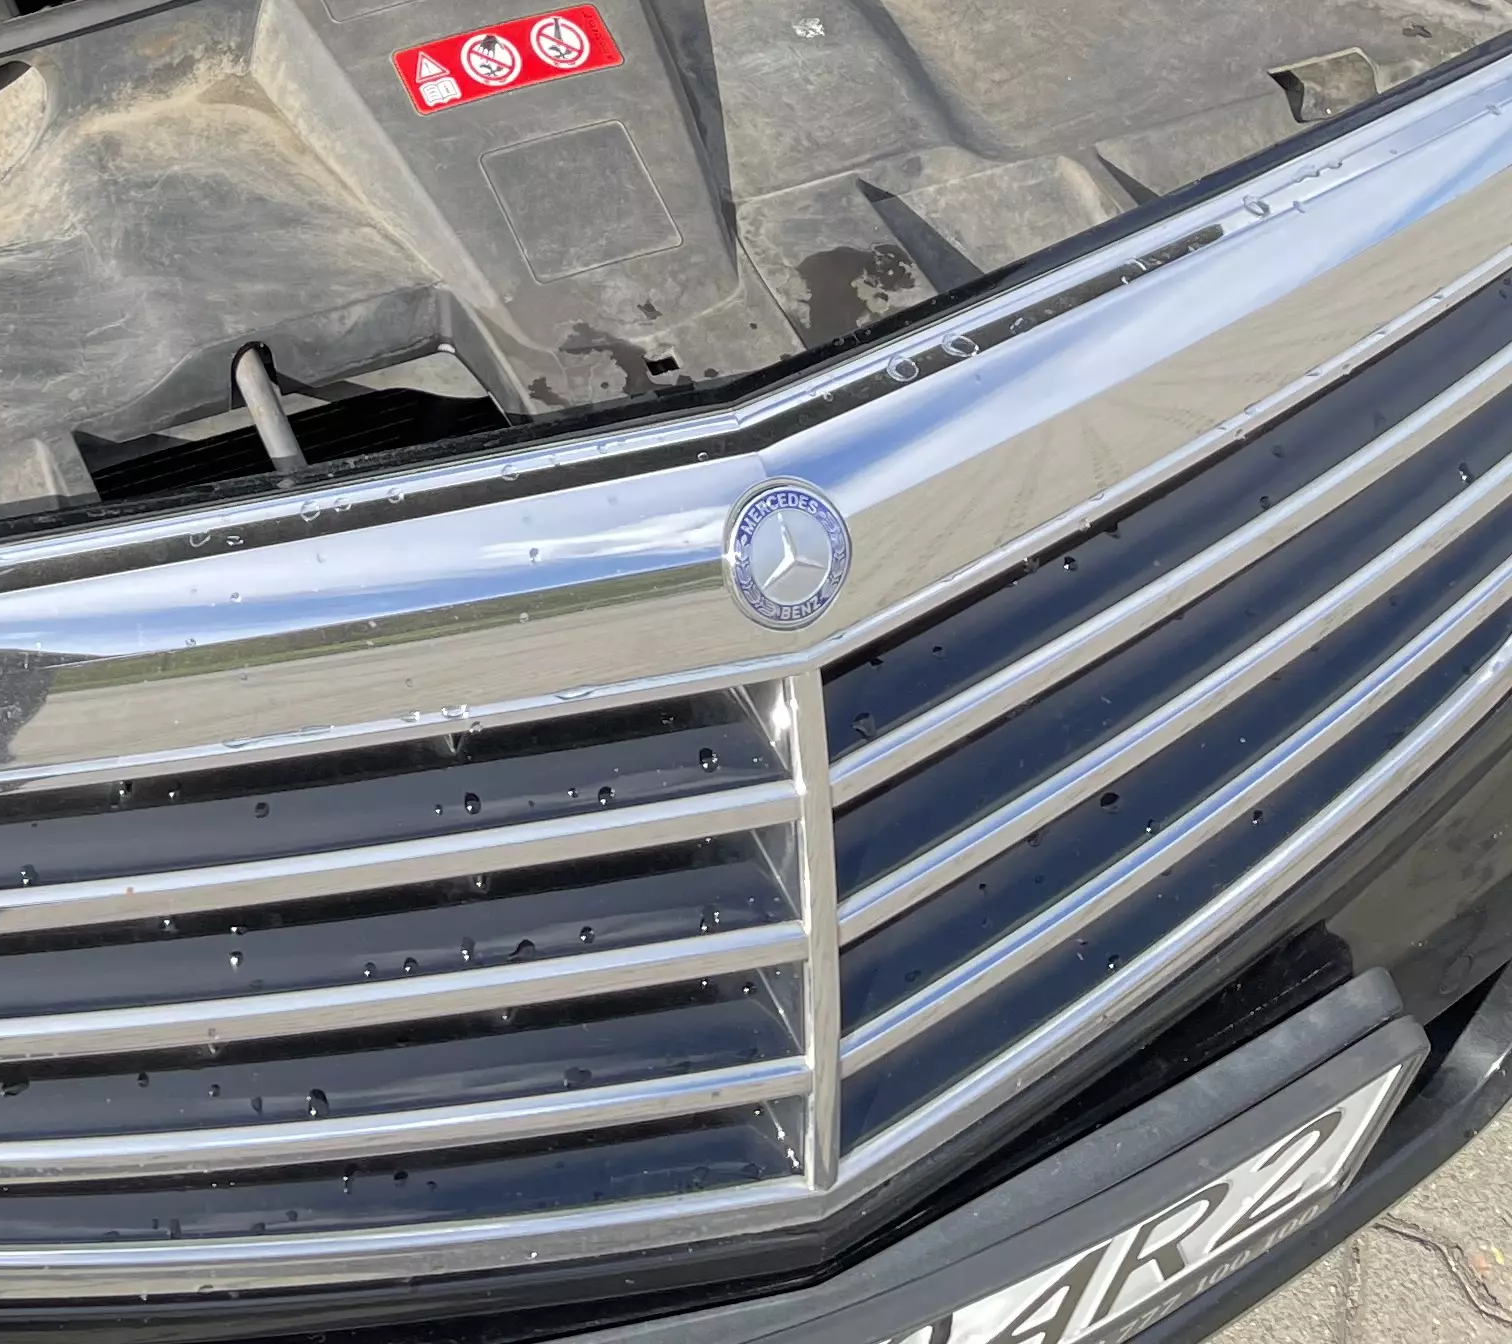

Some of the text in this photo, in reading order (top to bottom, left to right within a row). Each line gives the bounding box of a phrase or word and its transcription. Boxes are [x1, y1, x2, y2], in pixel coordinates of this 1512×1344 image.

[740, 492, 823, 621] MERCEDES BENZ
[1192, 1249, 1251, 1294] 100
[1265, 1204, 1320, 1248] 100
